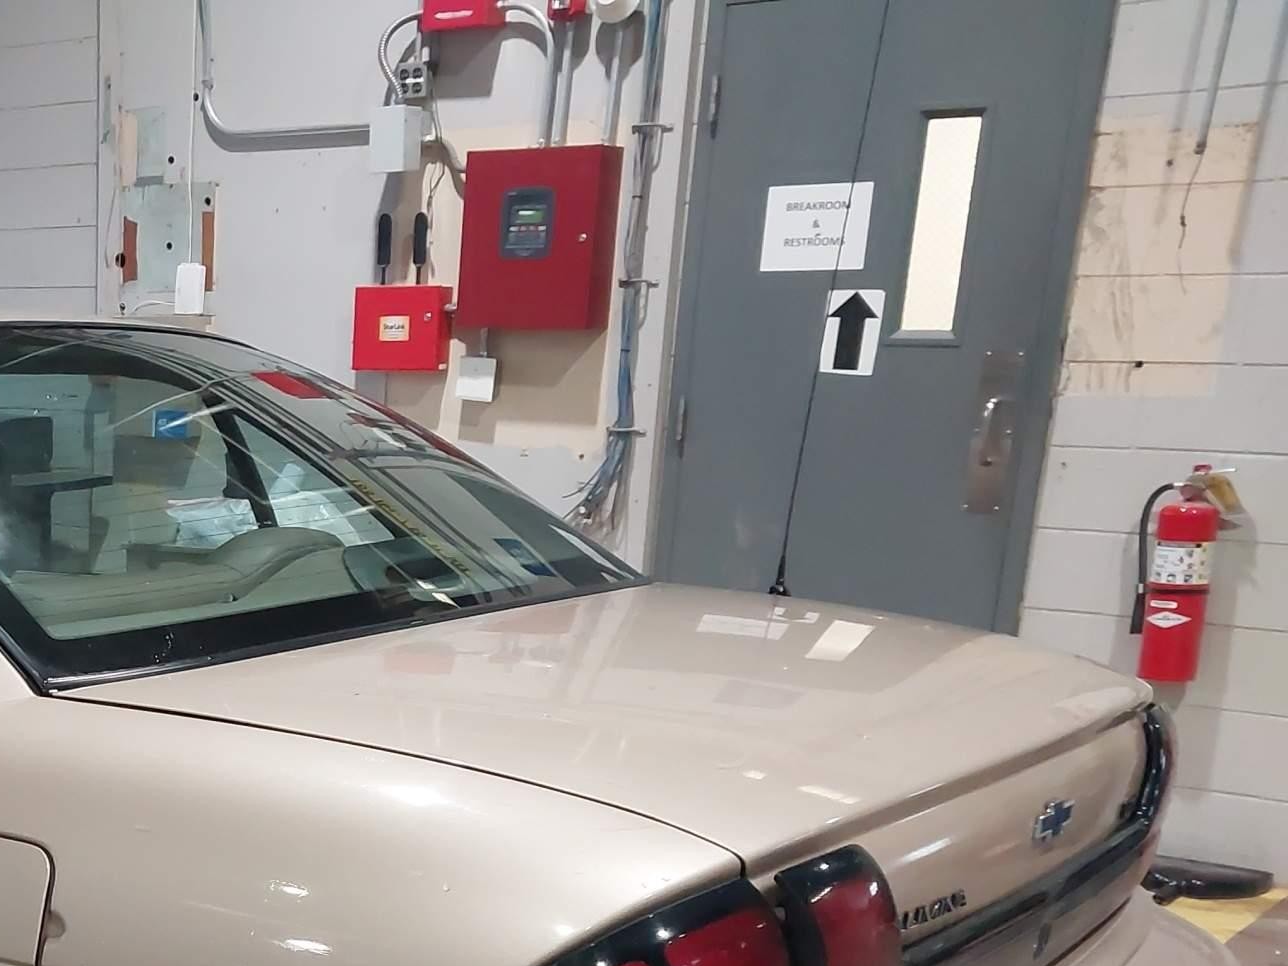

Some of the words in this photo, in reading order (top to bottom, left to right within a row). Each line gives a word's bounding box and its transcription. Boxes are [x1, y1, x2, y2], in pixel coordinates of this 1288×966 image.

[785, 200, 851, 212] BREAKROOM
[812, 219, 821, 229] &
[783, 236, 846, 247] RESTROOMS
